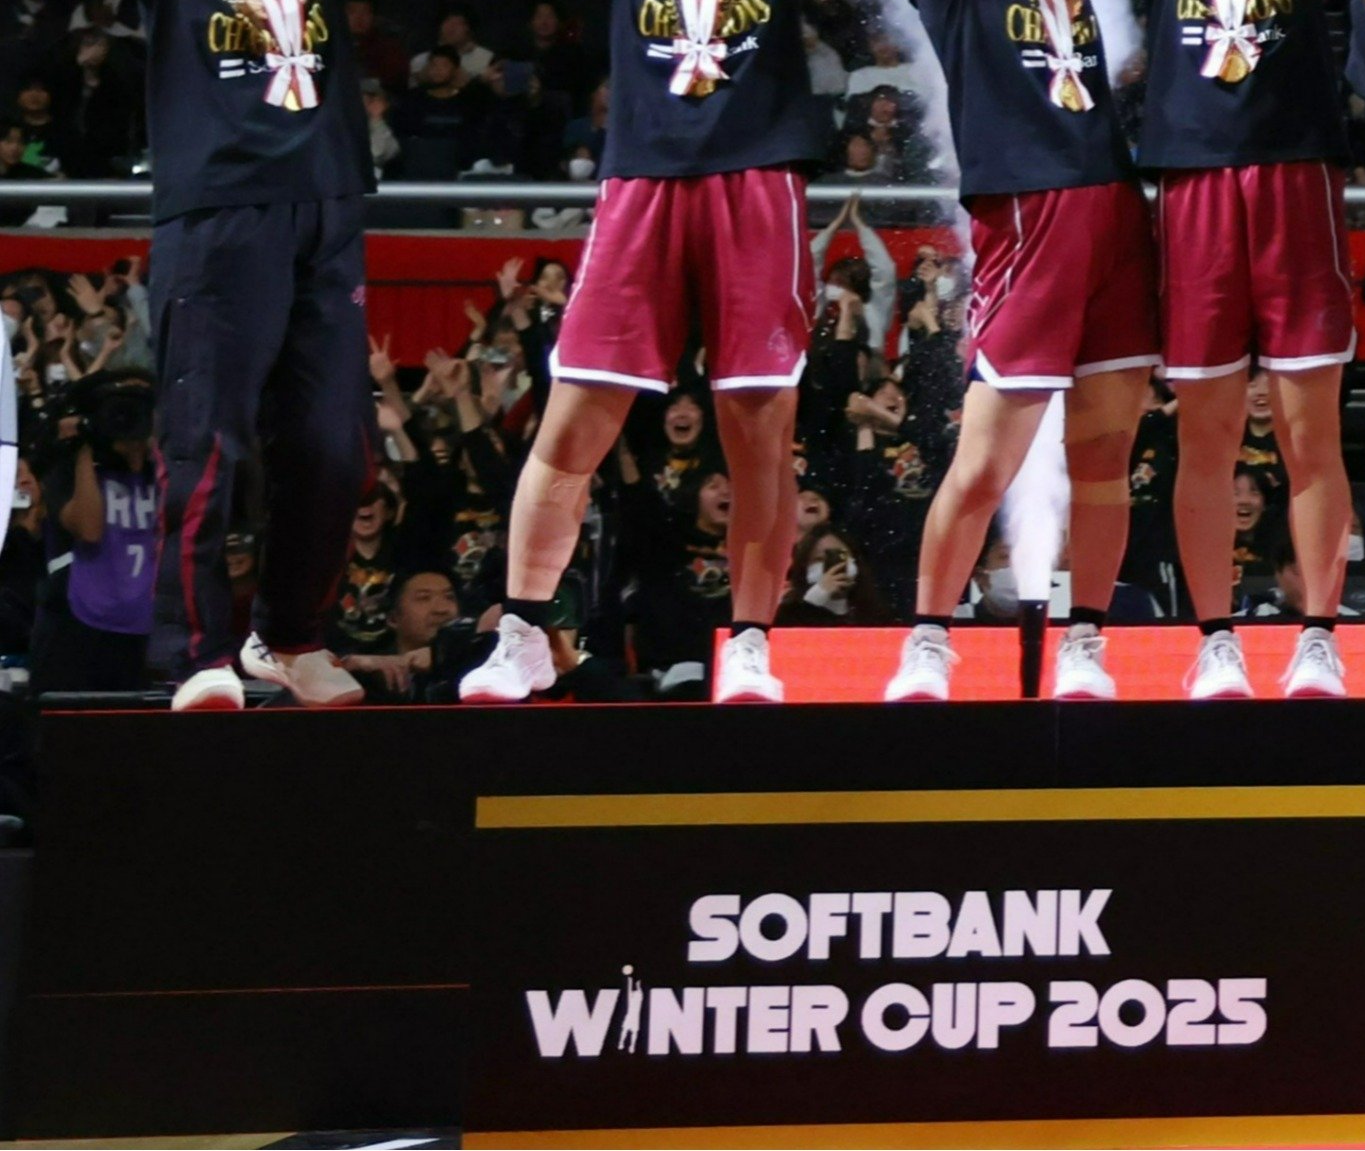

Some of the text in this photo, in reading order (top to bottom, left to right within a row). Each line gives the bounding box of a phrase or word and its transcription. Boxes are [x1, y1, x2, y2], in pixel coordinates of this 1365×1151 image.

[127, 543, 146, 579] 7
[687, 889, 1113, 962] SOFTBANK
[525, 970, 1267, 1058] WINTER CUP 2025
